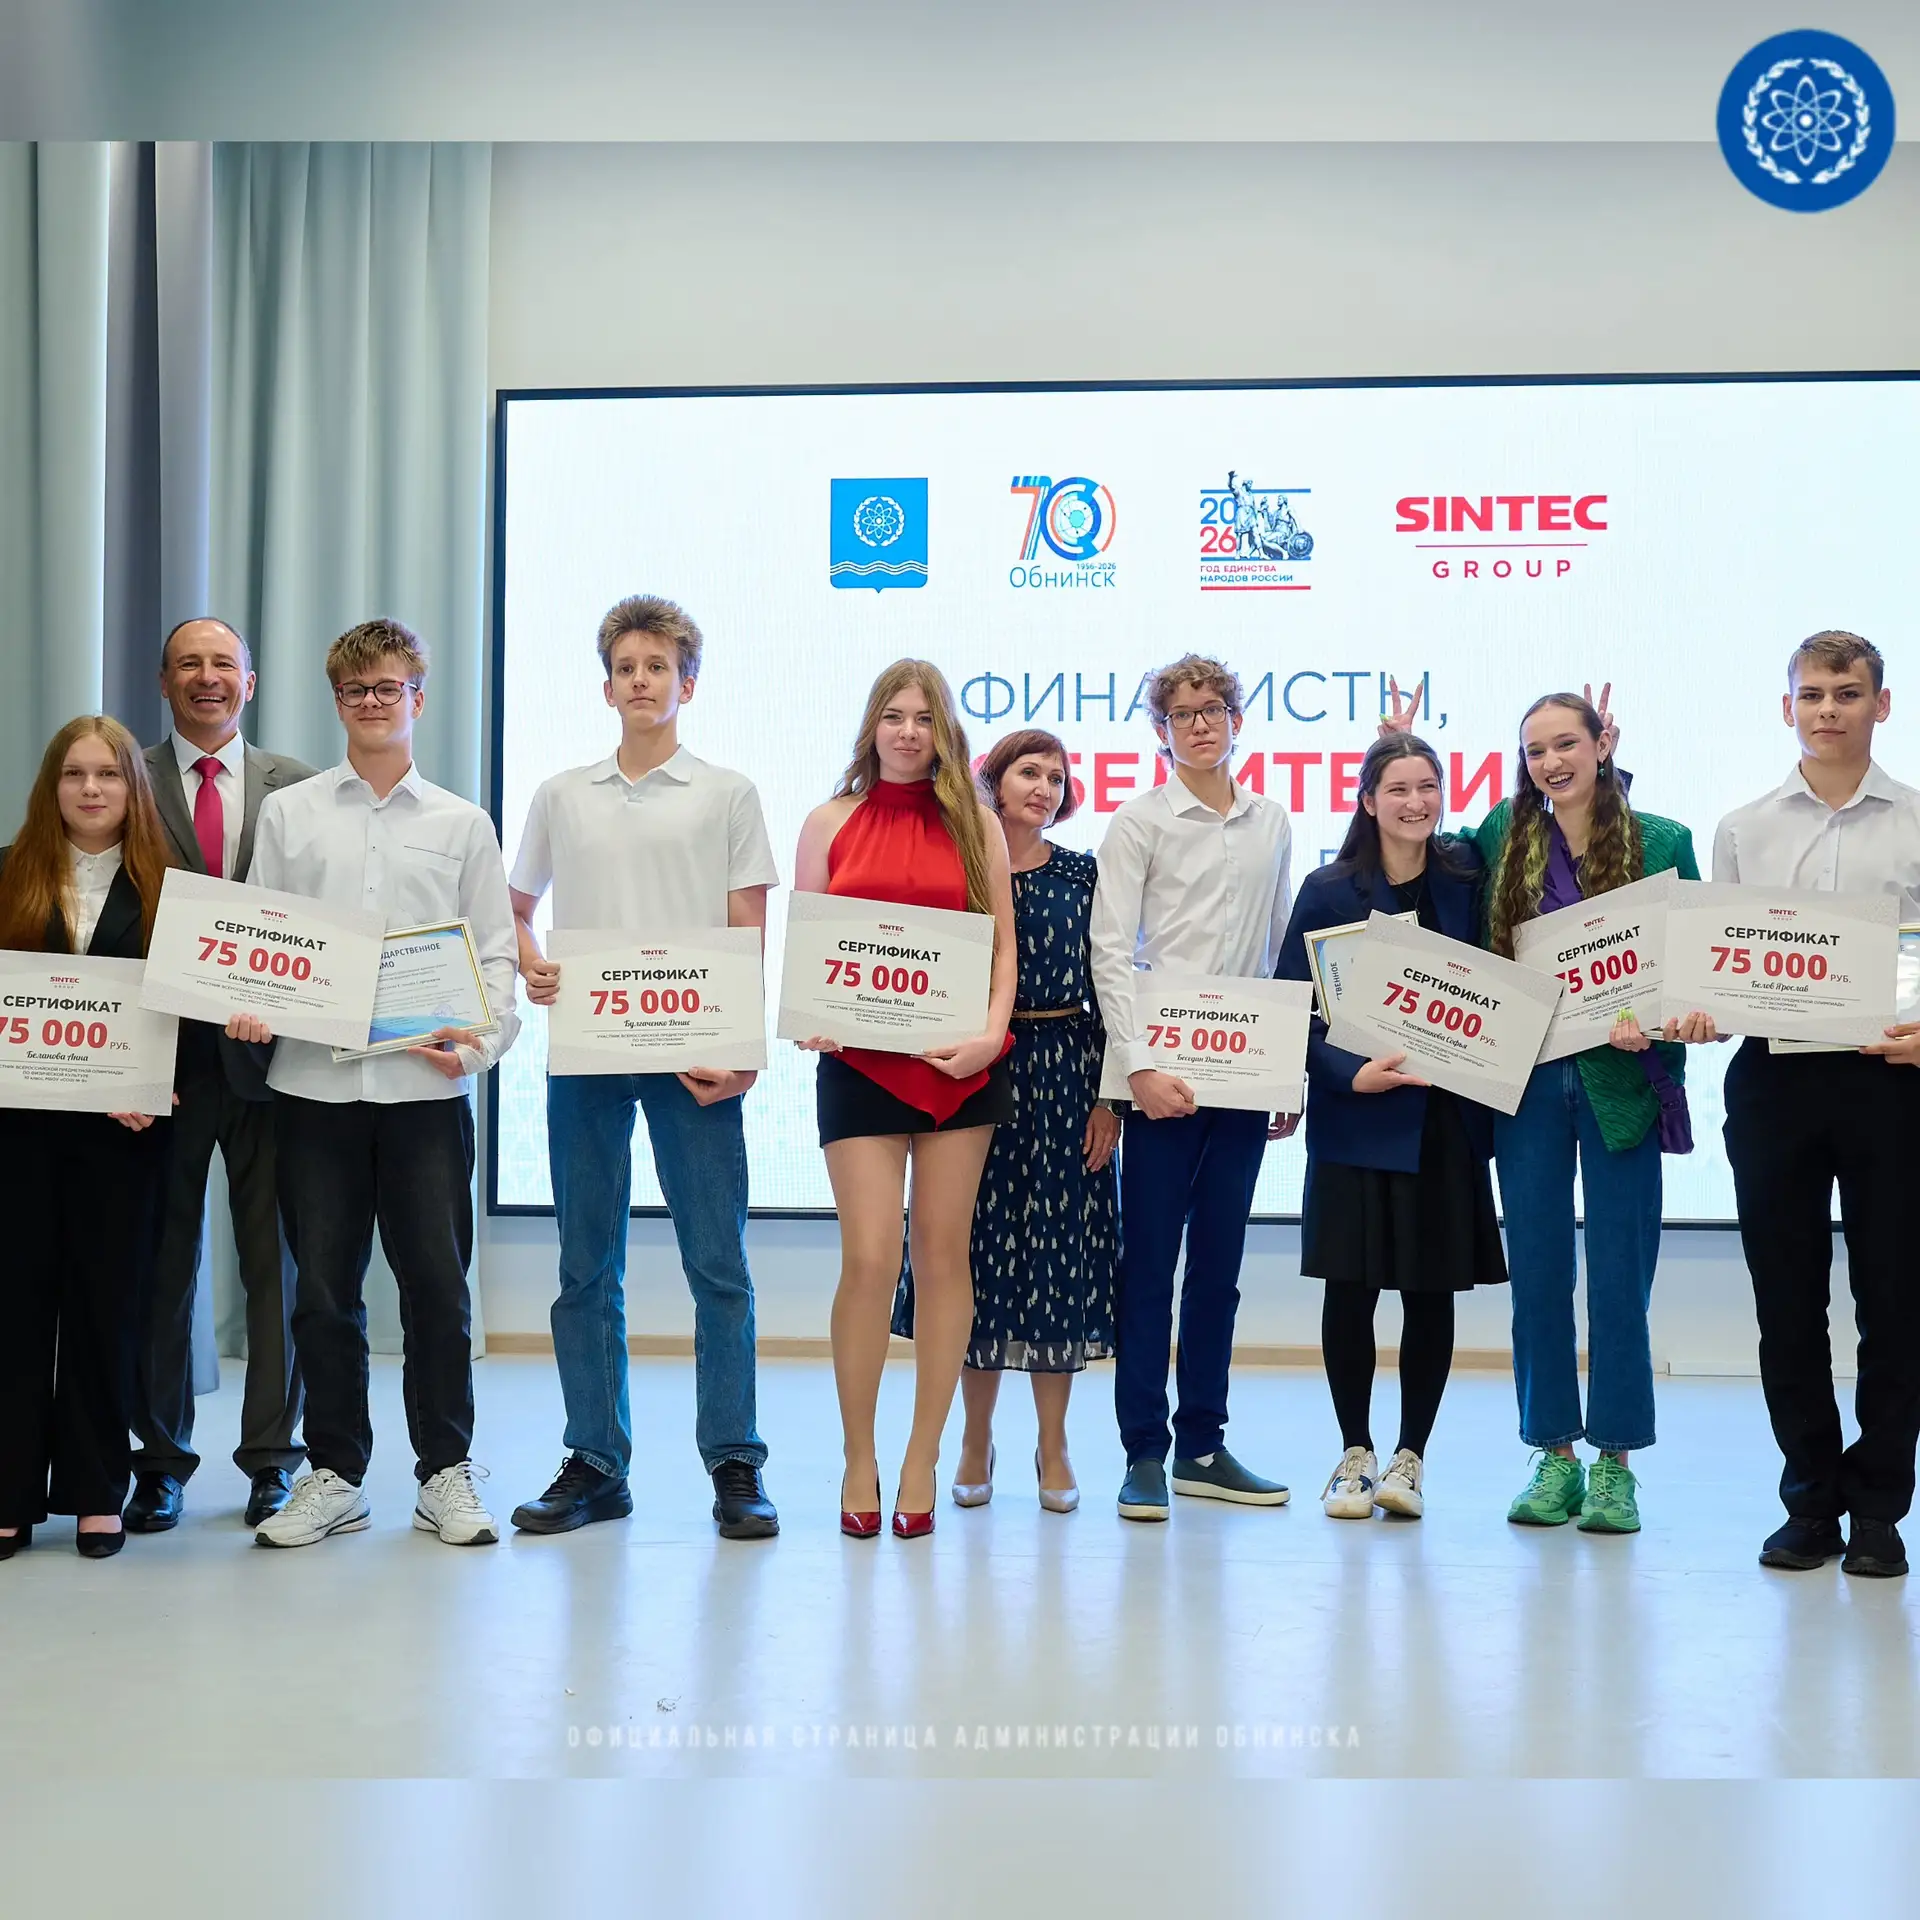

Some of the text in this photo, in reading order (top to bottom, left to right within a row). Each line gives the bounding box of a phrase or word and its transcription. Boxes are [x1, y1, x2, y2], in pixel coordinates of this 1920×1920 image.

[1200, 497, 1236, 525] 20
[1395, 495, 1608, 532] SINTEC
[1200, 526, 1237, 553] 26
[1009, 566, 1116, 588] Обнинск
[1200, 565, 1277, 573] ГОД ЕДИНСТВА
[1200, 574, 1293, 582] НАРОДОВ РОССИИ
[1432, 559, 1574, 579] GROUP
[260, 909, 288, 920] SINTEC
[1584, 916, 1605, 928] SINTEC
[1768, 908, 1798, 916] SINTEC
[215, 920, 326, 951] СЕРТИФИКАТ
[878, 924, 904, 932] SINTEC
[1724, 926, 1840, 946] СЕРТИФИКАТ
[838, 940, 940, 962] СЕРТИФИКАТ
[1558, 926, 1640, 962] СЕРТИФИКАТ
[198, 936, 332, 987] 75 000 РУБ.
[1447, 961, 1472, 974] SINTEC
[1590, 949, 1638, 986] 000
[1640, 960, 1657, 970] РУБ.
[1710, 946, 1851, 984] 75 000 РУБ.
[50, 976, 80, 984] SINTEC
[602, 968, 708, 981] СЕРТИФИКАТ
[825, 959, 948, 998] 75 000 РУБ.
[268, 980, 296, 992] Степан
[1404, 967, 1500, 1011] СЕРТИФИКАТ
[1750, 980, 1808, 992] Белов Ярослав
[4, 996, 121, 1013] СЕРТИФИКАТ
[590, 990, 629, 1015] 75
[640, 989, 700, 1014] 000
[893, 998, 914, 1007] Юлия
[1160, 1008, 1259, 1024] СЕРТИФИКАТ
[1383, 981, 1498, 1048] 75 000 РУБ.
[42, 1020, 108, 1048] 000
[110, 1042, 131, 1050] РУБ.
[1146, 1025, 1266, 1056] 75 000 РУБ.
[1447, 1035, 1468, 1050] Софья
[26, 1050, 88, 1062] Беланова Анна
